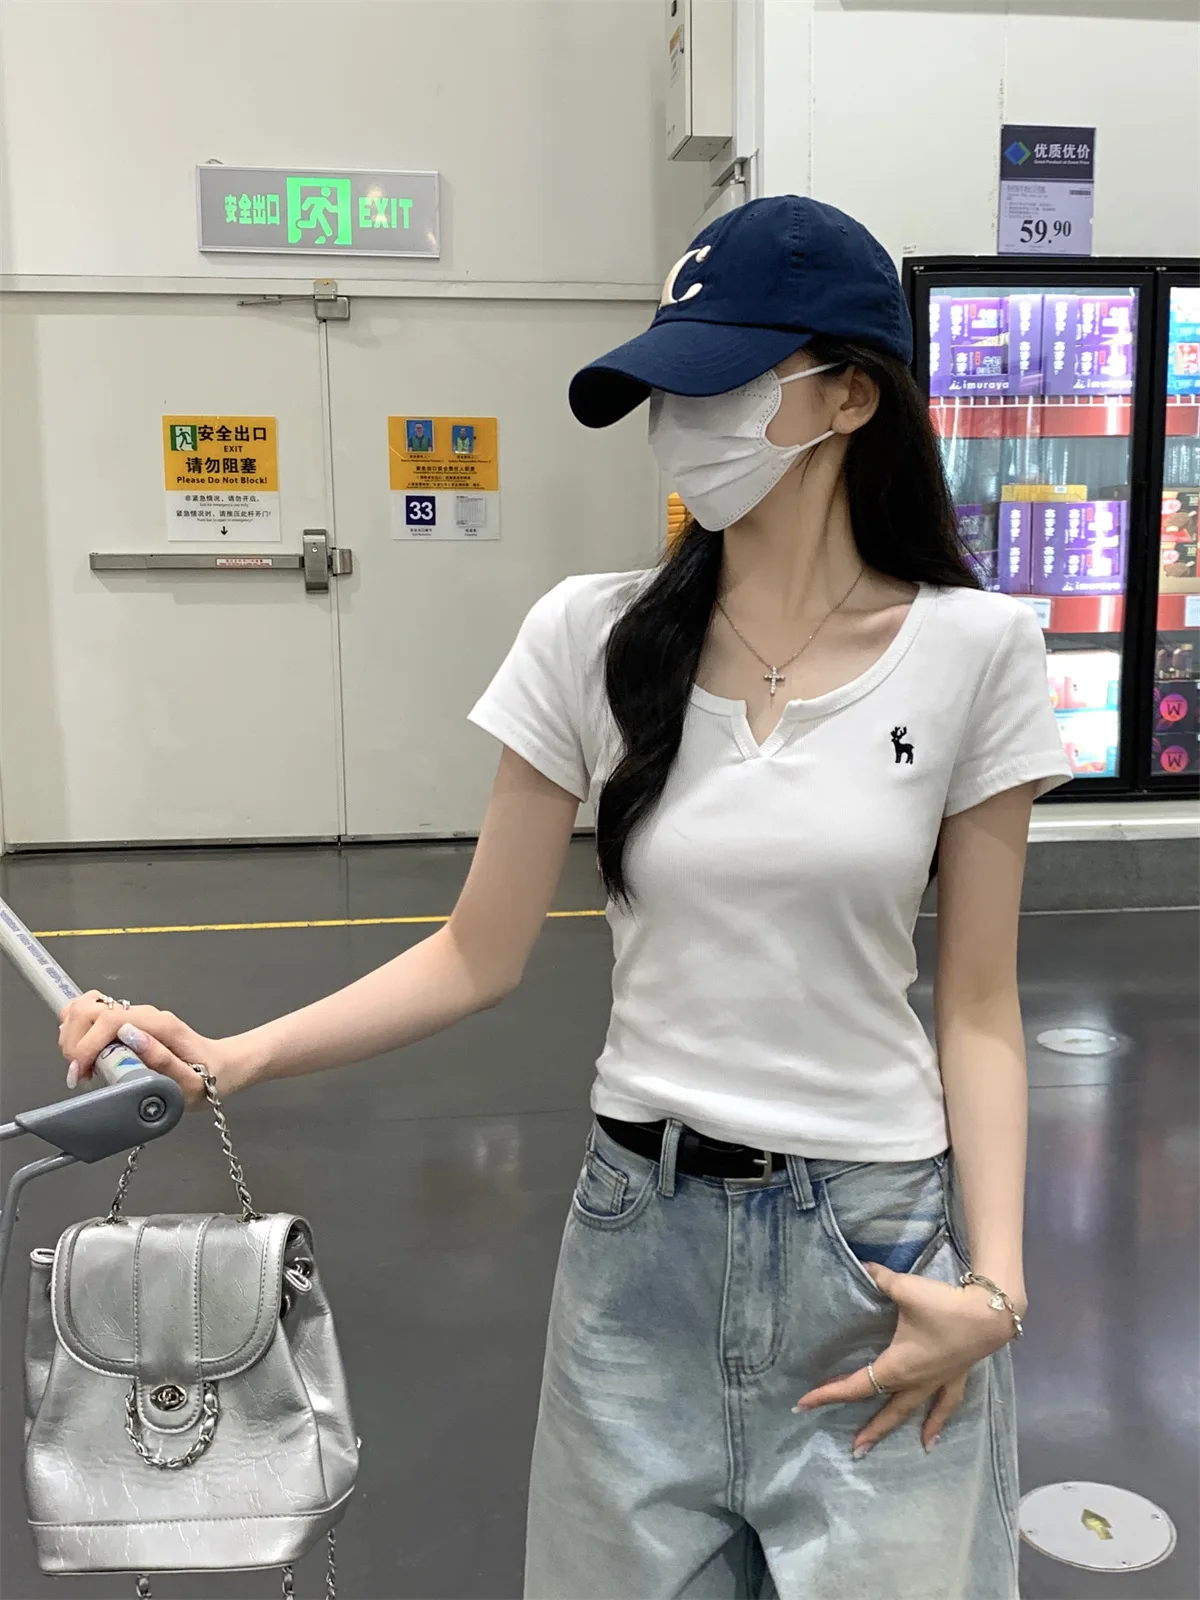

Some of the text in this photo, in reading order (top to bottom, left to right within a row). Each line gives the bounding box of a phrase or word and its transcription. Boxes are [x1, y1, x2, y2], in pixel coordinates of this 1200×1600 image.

[1034, 143, 1091, 159] 优质优价
[224, 193, 280, 225] 安全出口
[359, 196, 413, 229] EXIT
[1020, 219, 1072, 244] 59.90
[658, 244, 712, 311] C
[963, 380, 1010, 390] imuraya
[198, 425, 267, 442] 安全出口
[224, 445, 243, 453] EXIT
[186, 457, 257, 474] 请勿阻塞
[177, 476, 268, 484] Please Do Not Block!
[409, 501, 434, 520] 33
